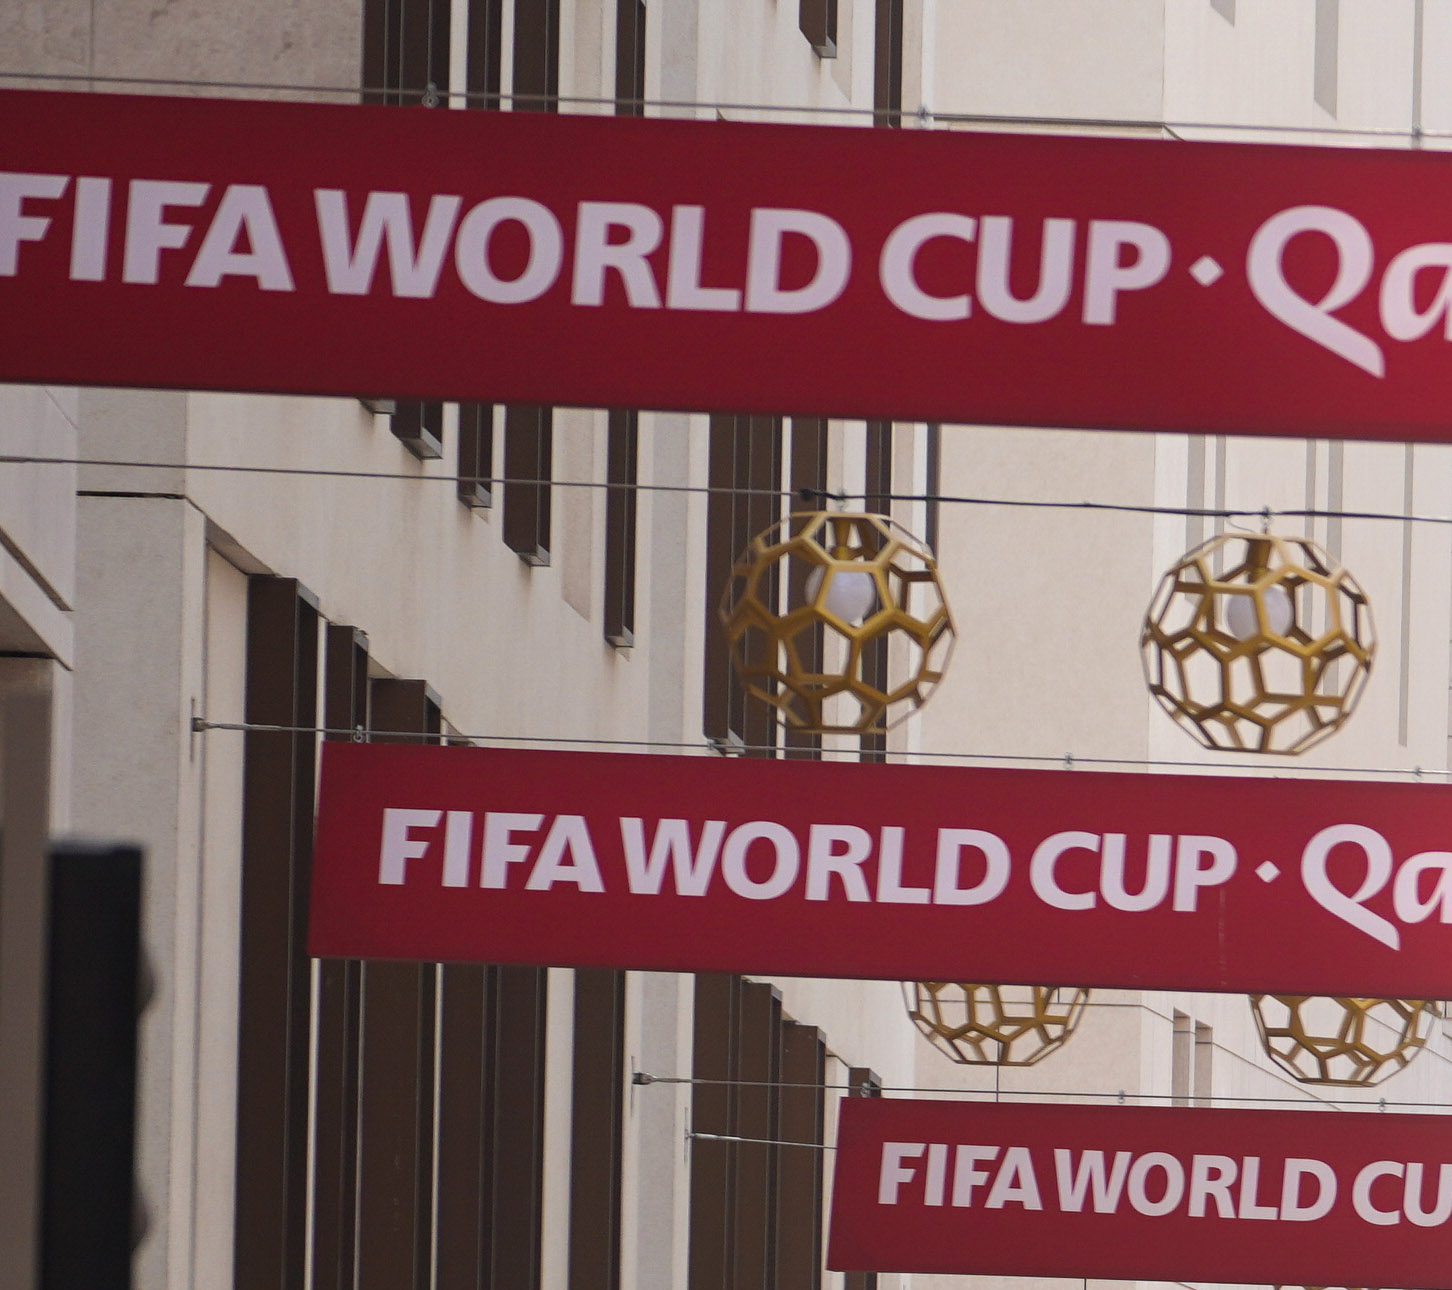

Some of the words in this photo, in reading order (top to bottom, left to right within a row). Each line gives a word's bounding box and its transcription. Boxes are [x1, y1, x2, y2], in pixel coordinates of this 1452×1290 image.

[0, 172, 295, 291] FIFA
[314, 189, 850, 313] WORLD
[880, 212, 1171, 324] CUP
[379, 808, 604, 893] FIFA
[619, 817, 1010, 905] WORLD
[1029, 831, 1238, 911] CUP
[878, 1141, 1042, 1210] FIFA
[1054, 1149, 1337, 1222] WORLD
